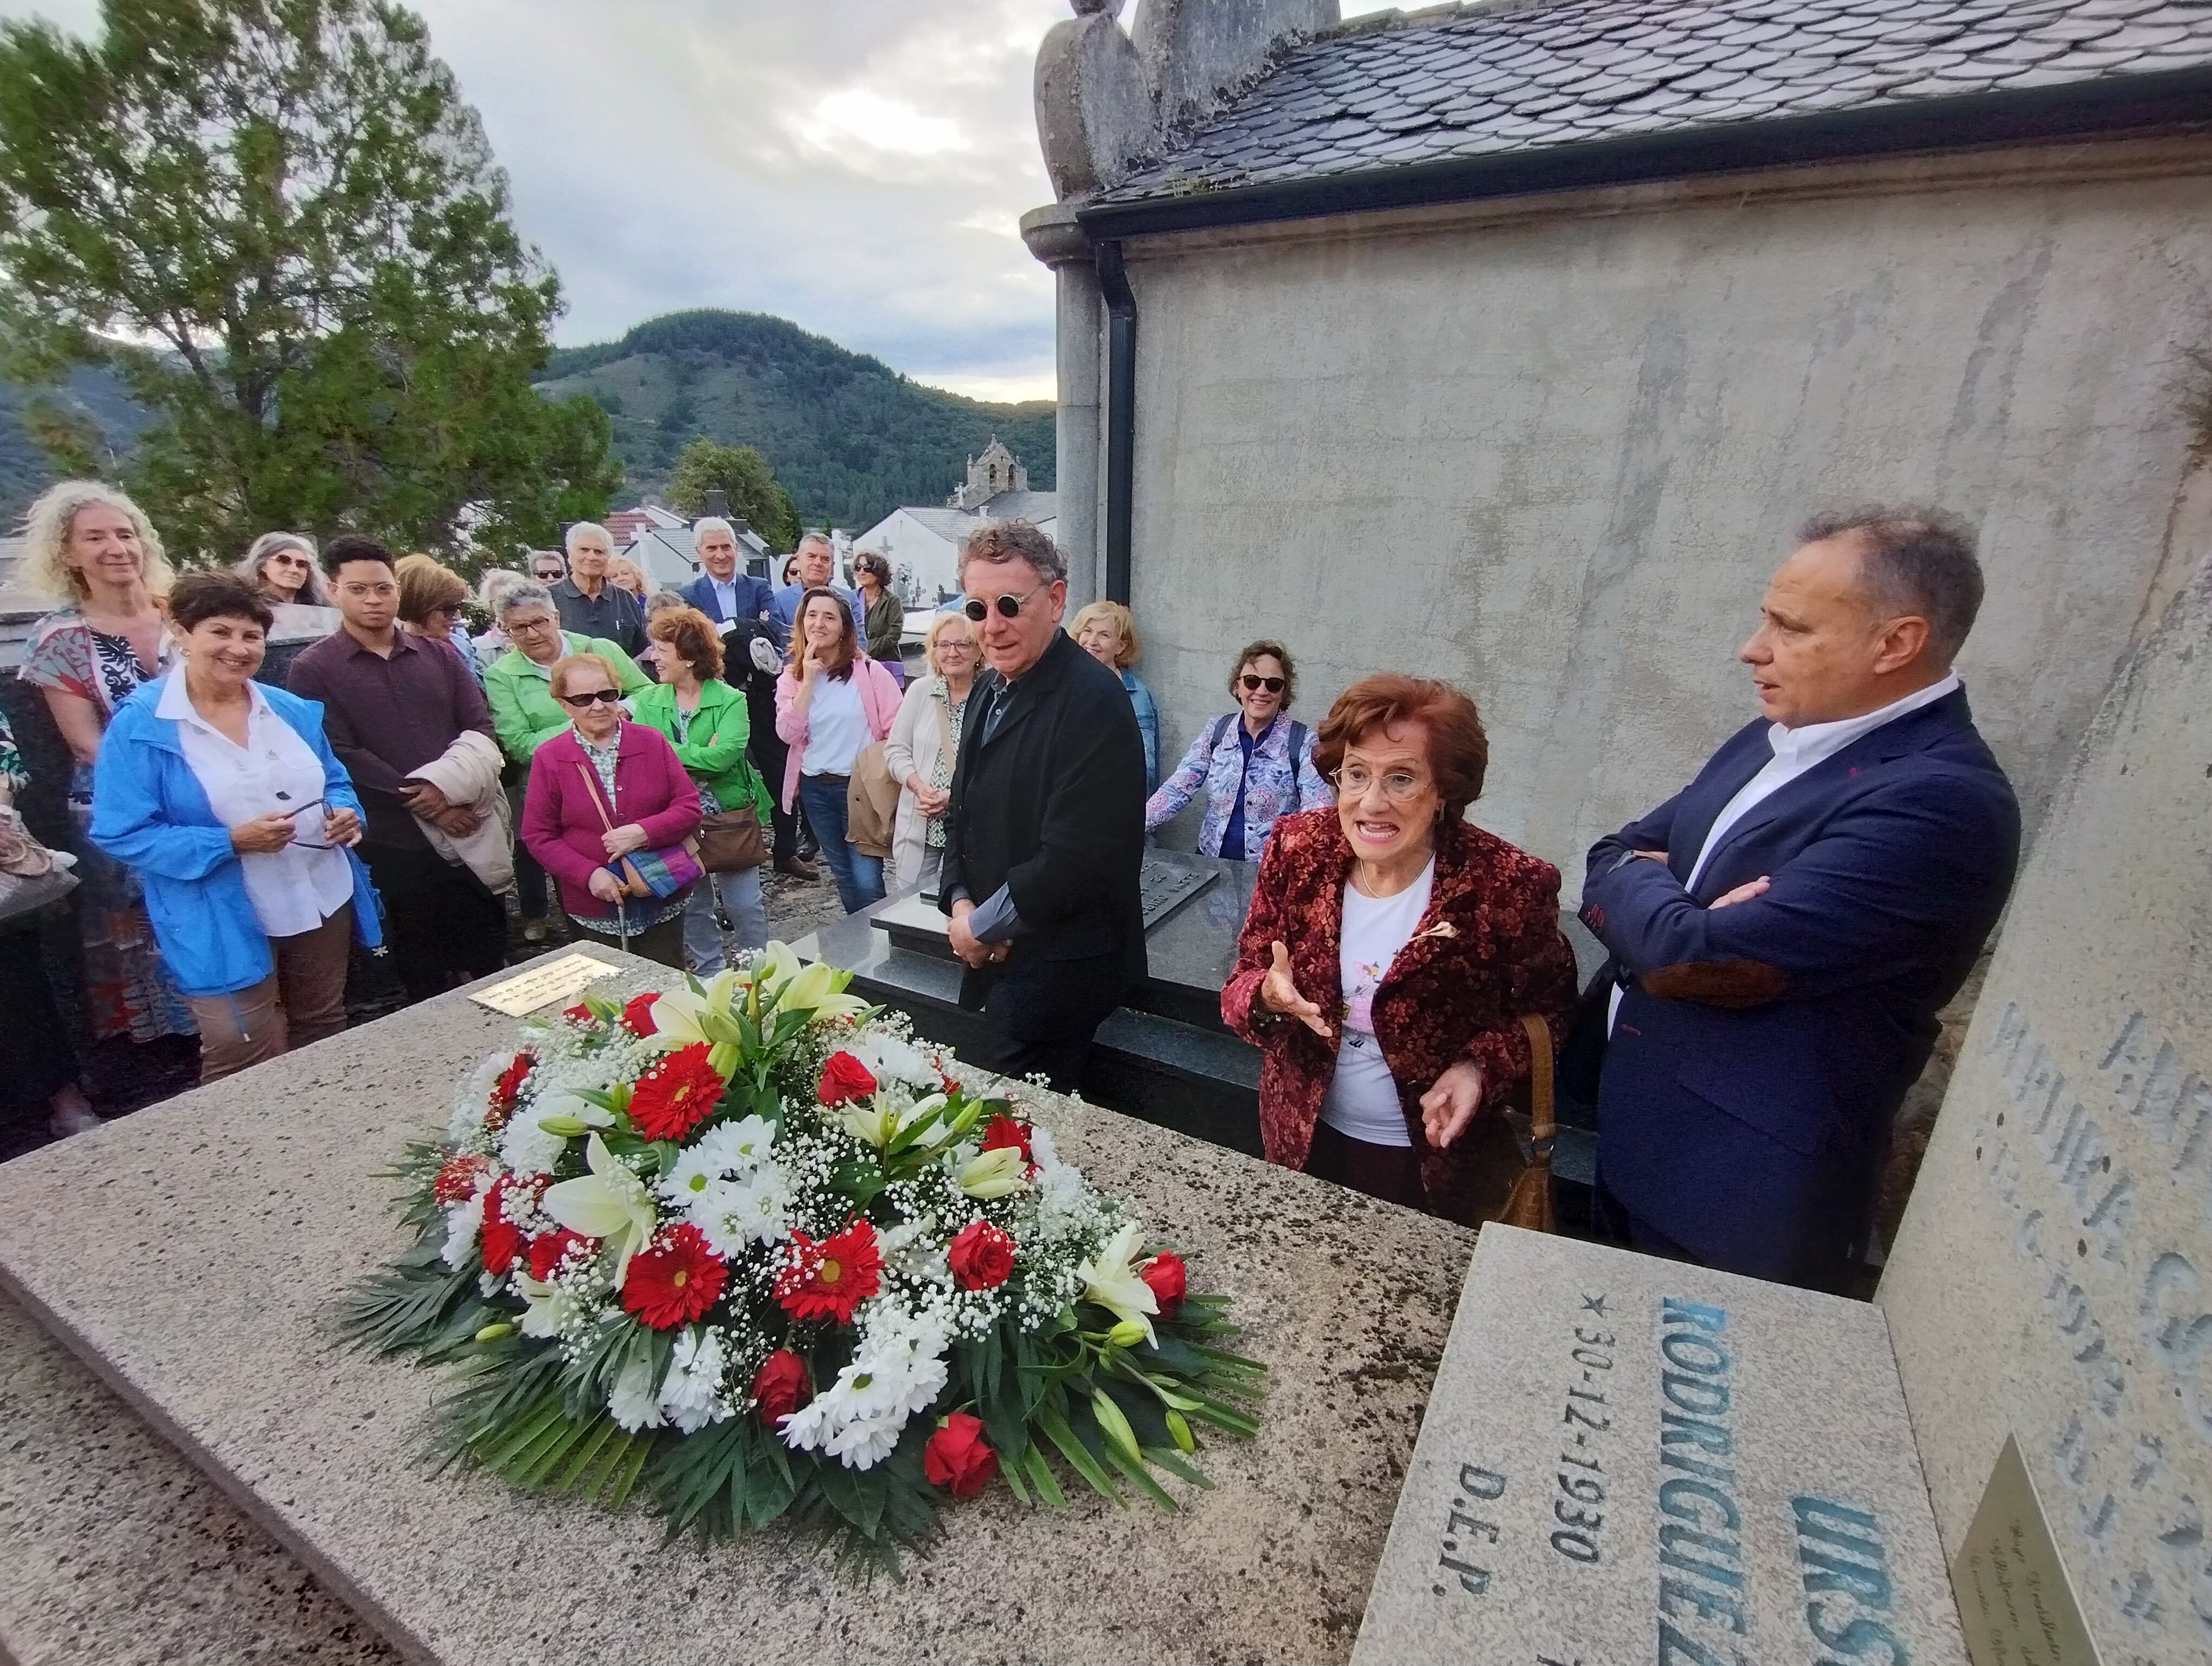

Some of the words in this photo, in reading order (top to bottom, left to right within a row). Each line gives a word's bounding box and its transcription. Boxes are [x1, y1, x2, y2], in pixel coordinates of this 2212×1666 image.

[1432, 1463, 1508, 1597] D.E.P.
[1551, 1327, 1616, 1563] 30-12-1930
[1791, 1495, 1915, 1666] URS
